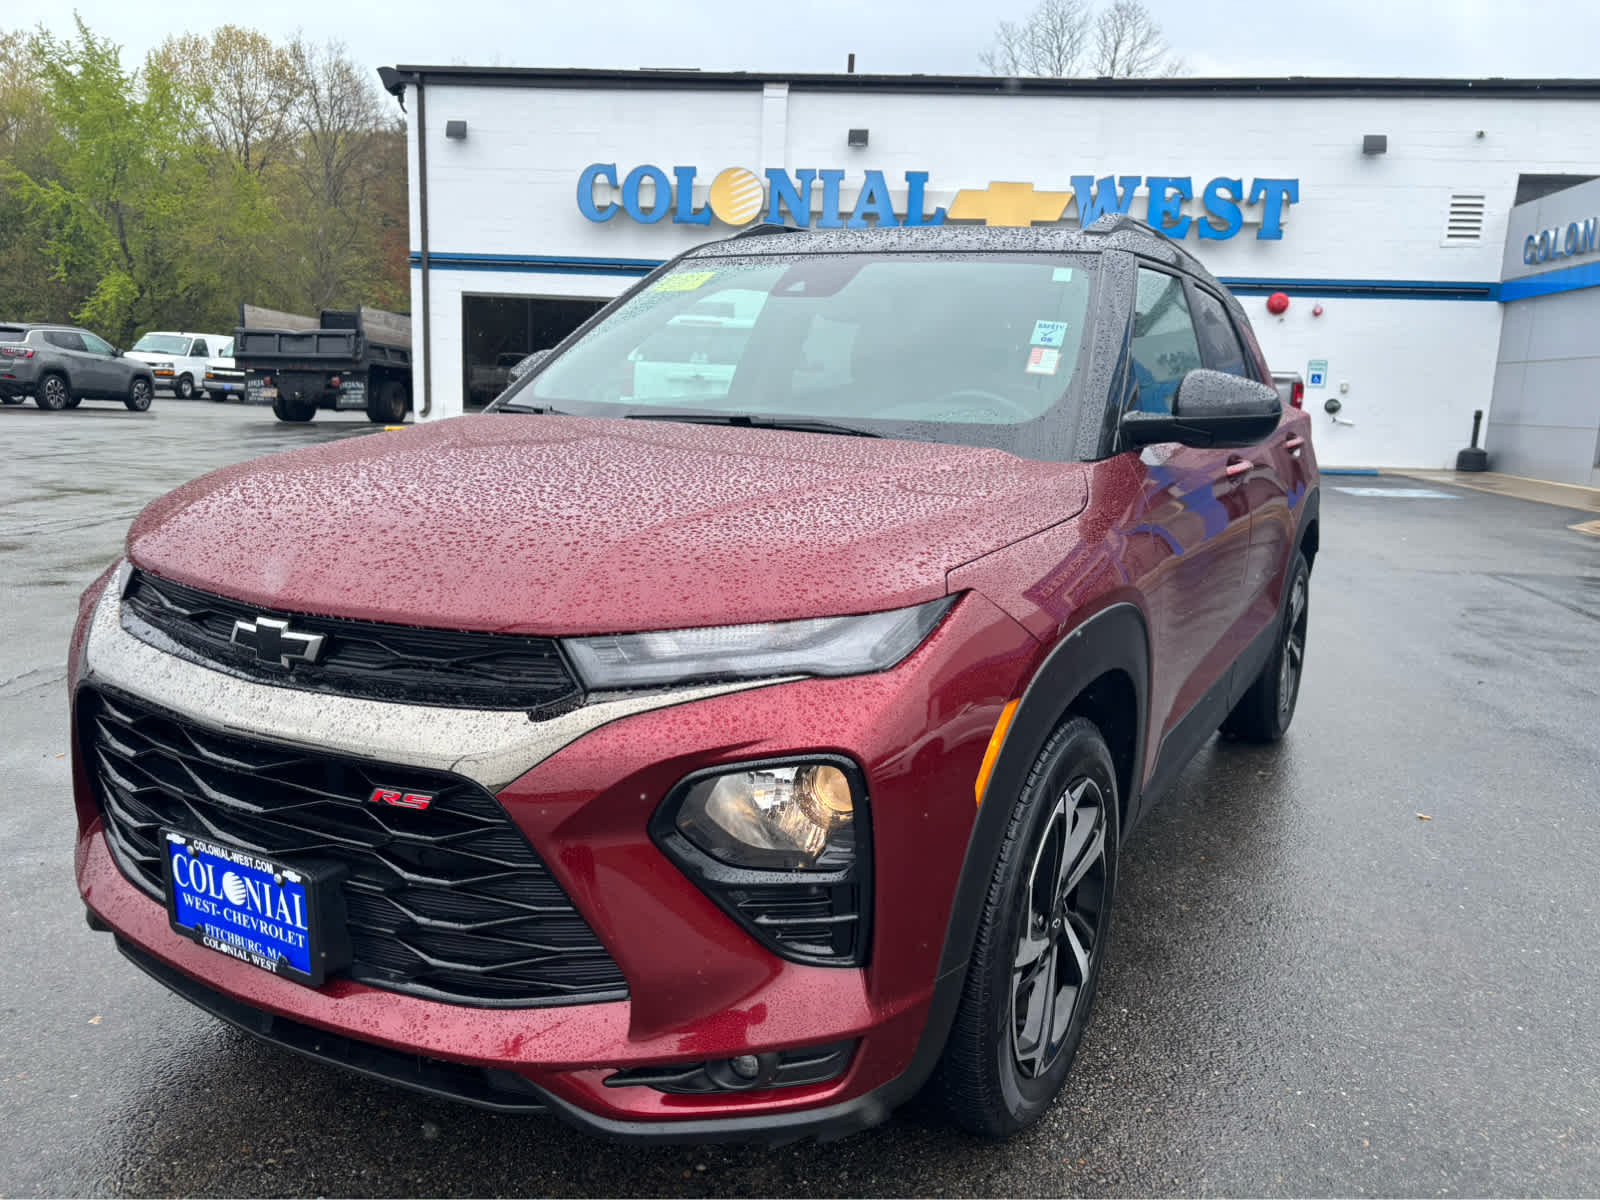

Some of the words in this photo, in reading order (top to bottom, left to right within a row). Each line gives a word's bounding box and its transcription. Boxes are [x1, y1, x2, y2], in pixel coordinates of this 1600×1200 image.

[577, 162, 946, 228] COLONIAL
[1070, 175, 1299, 241] WEST
[1523, 217, 1600, 264] COLON
[368, 788, 432, 810] RS
[193, 840, 274, 875] COLONIAL-WEST.COM
[172, 853, 308, 930] COLONIAL
[223, 907, 305, 948] CHEVROLET
[203, 936, 250, 962] COLONIAL
[252, 955, 278, 973] WEST
